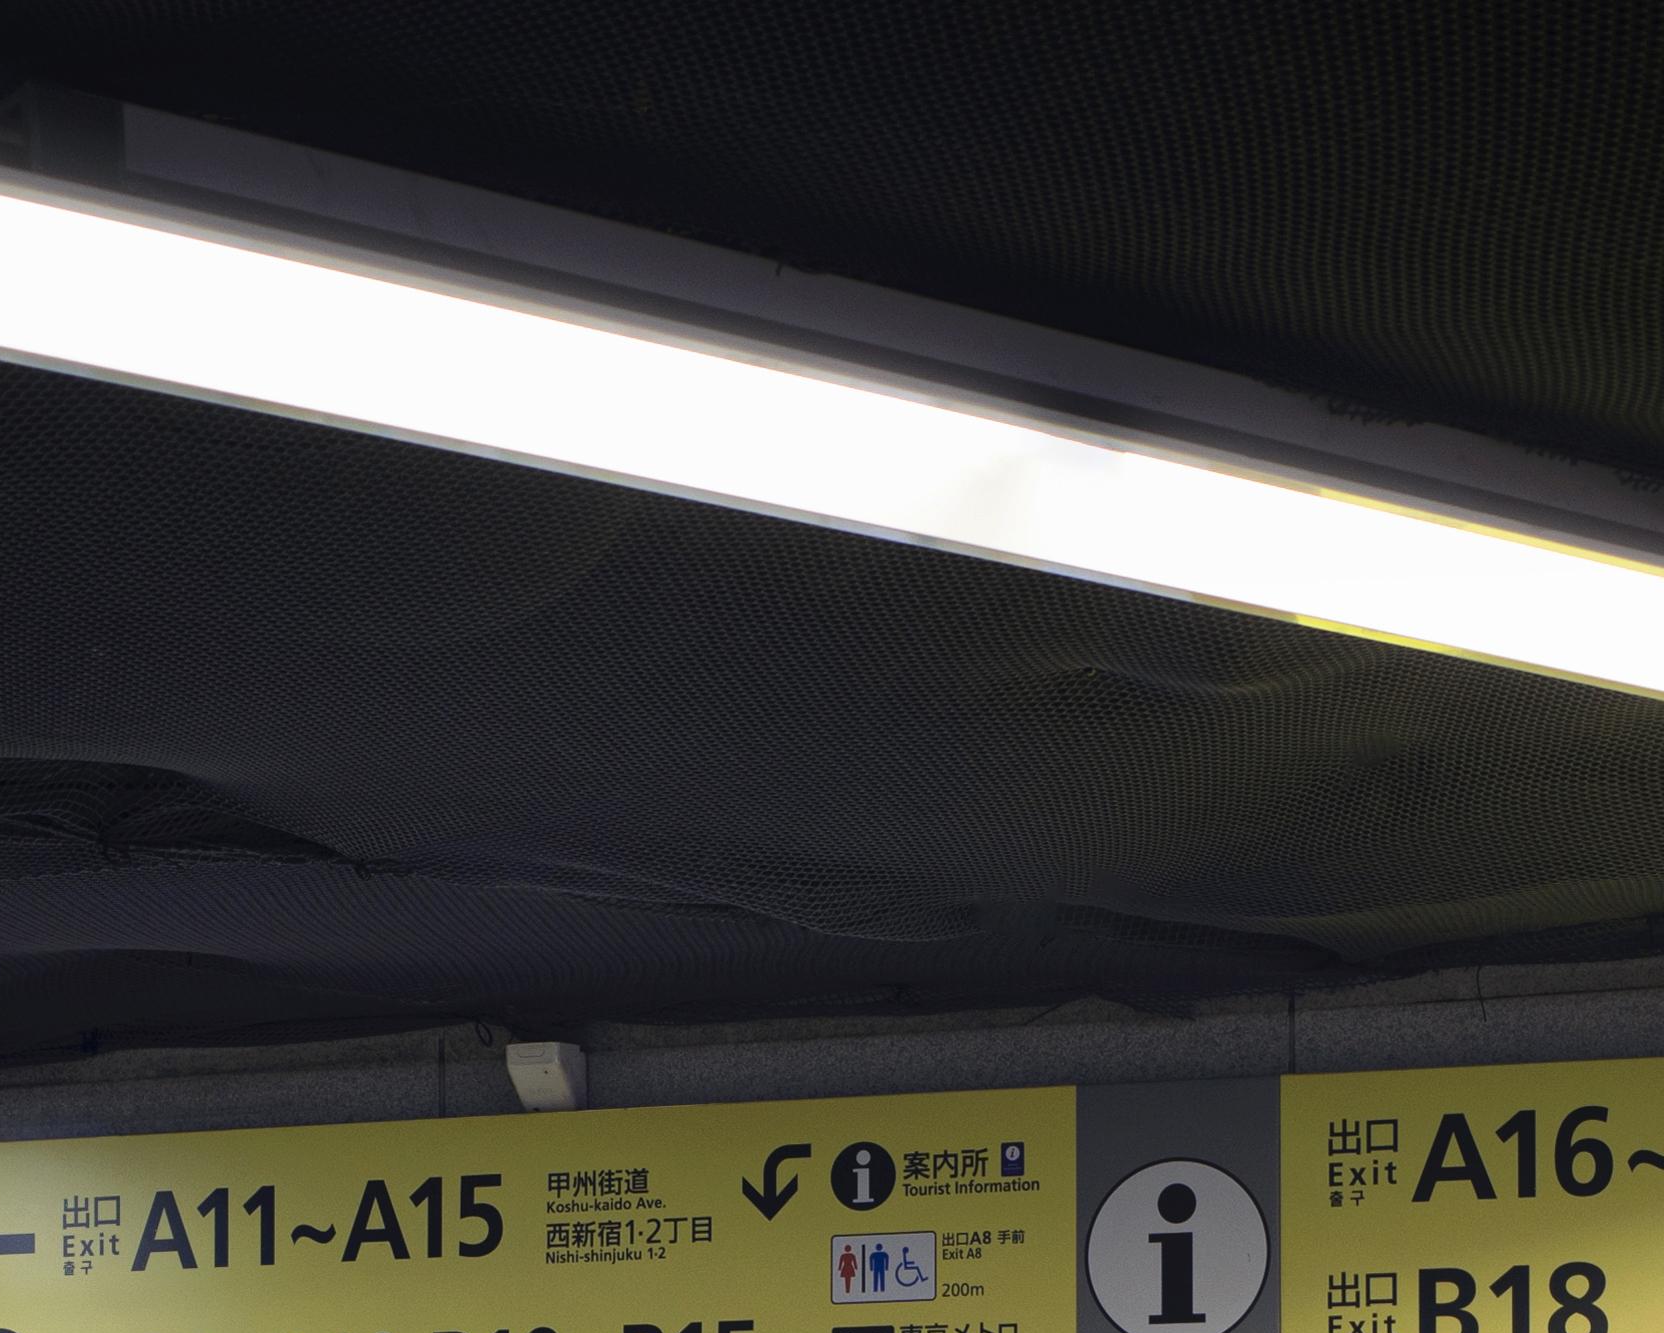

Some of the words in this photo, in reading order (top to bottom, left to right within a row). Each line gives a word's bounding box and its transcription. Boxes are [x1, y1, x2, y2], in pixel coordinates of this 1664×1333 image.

[1328, 1119, 1398, 1156] 出口
[904, 1148, 988, 1180] 案内所
[1329, 1160, 1397, 1187] Exit
[548, 1168, 649, 1200] 甲州街道
[902, 1182, 951, 1197] Tourist
[954, 1177, 1040, 1194] Information
[63, 1196, 120, 1229] 出口
[547, 1197, 631, 1213] Koshu-kaido
[636, 1197, 666, 1209] Ave.
[63, 1232, 119, 1257] Exit
[942, 1231, 991, 1246] 出口A8
[997, 1230, 1025, 1244] 手前
[546, 1248, 641, 1264] Nishi-shinjuku
[943, 1248, 963, 1260] Exit
[967, 1248, 981, 1259] A8
[942, 1283, 984, 1297] 200m
[1328, 1272, 1397, 1309] 出口
